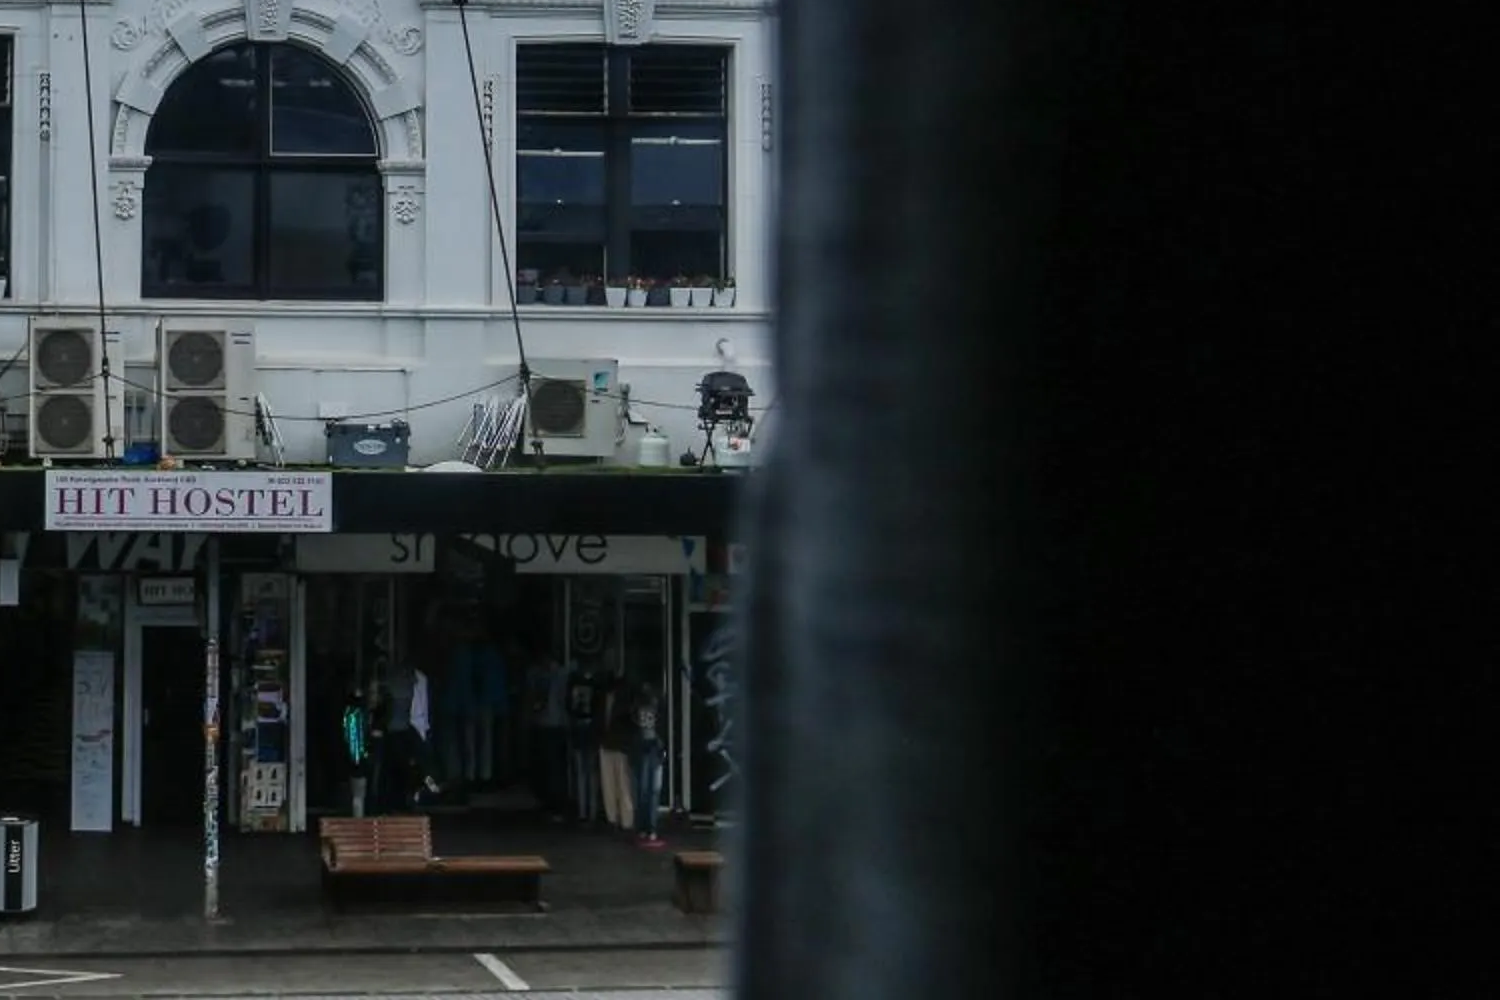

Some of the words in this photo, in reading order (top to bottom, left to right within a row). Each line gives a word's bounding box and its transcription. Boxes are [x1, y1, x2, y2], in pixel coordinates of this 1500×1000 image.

[54, 487, 135, 515] HIT
[147, 487, 323, 517] HOSTEL
[7, 838, 21, 874] Litter
